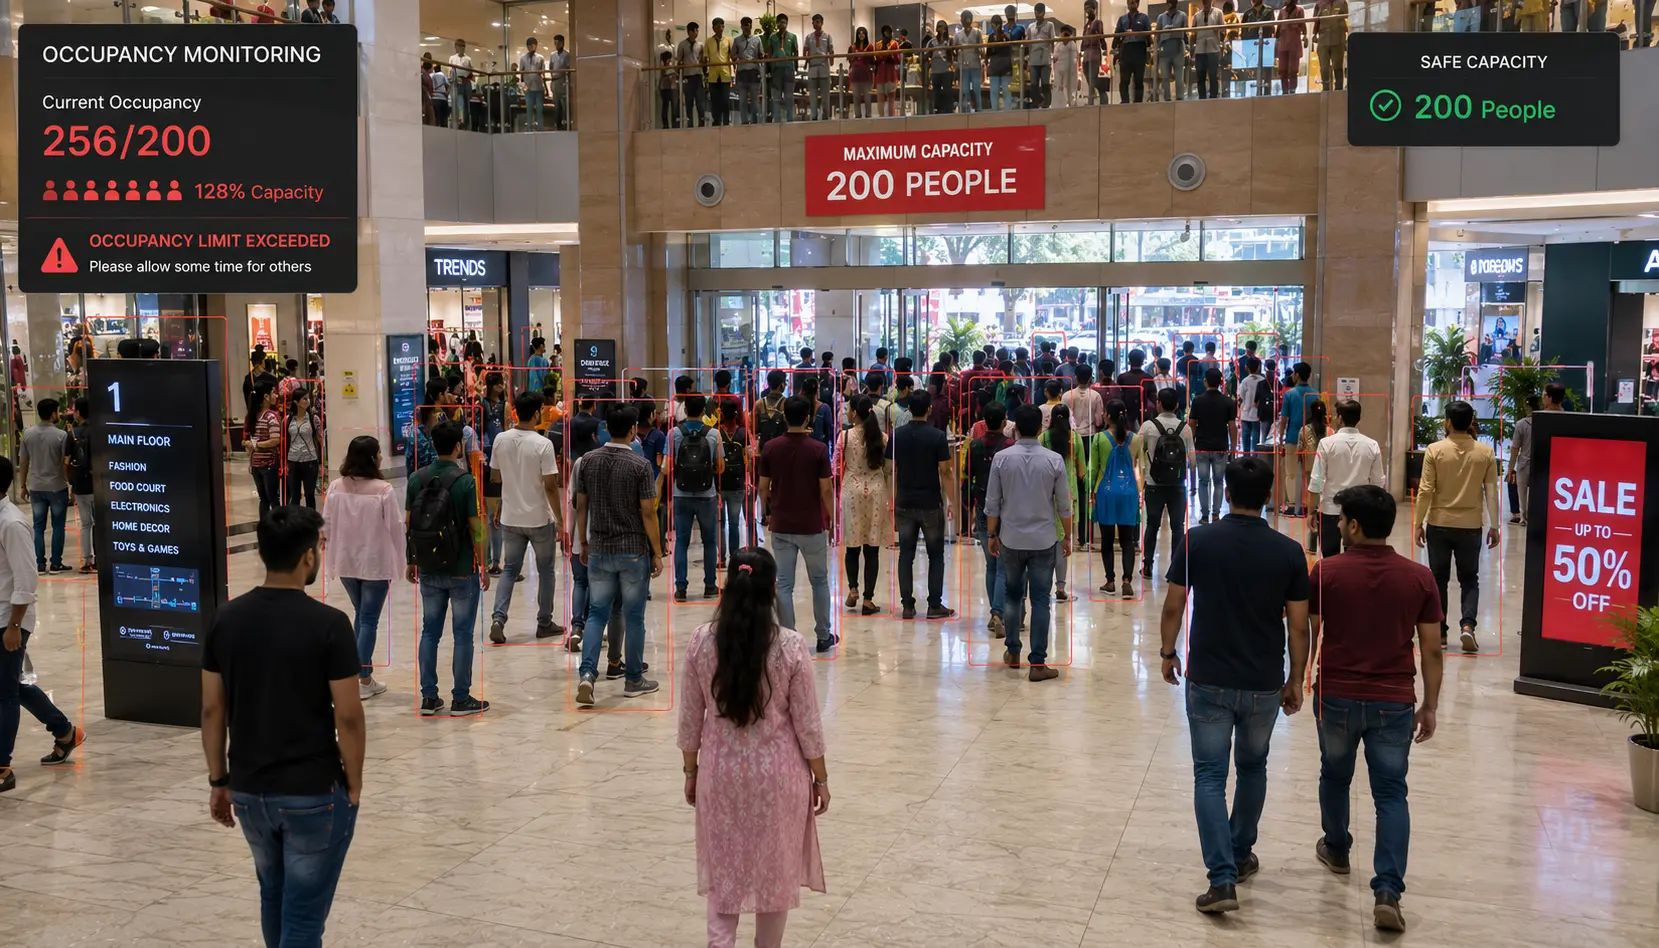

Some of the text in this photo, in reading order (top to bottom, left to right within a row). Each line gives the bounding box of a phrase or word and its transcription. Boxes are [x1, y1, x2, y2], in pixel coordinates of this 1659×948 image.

[843, 141, 993, 161] MAXIMUM CAPACITY
[826, 167, 1017, 201] 200 PEOPLE
[433, 258, 487, 277] TRENDS
[107, 381, 121, 413] 1
[107, 434, 171, 447] MAIN FLOOR
[108, 461, 147, 472] FASHION
[109, 481, 167, 493] FOOD COURT
[1553, 477, 1637, 516] SALE
[110, 500, 171, 514] ELECTRONICS
[111, 520, 171, 534] HOME DECOR
[1574, 522, 1612, 539] UP TO
[112, 541, 180, 555] TOYS & GAMES
[1553, 544, 1632, 589] 50%
[1572, 592, 1611, 612] OFF
